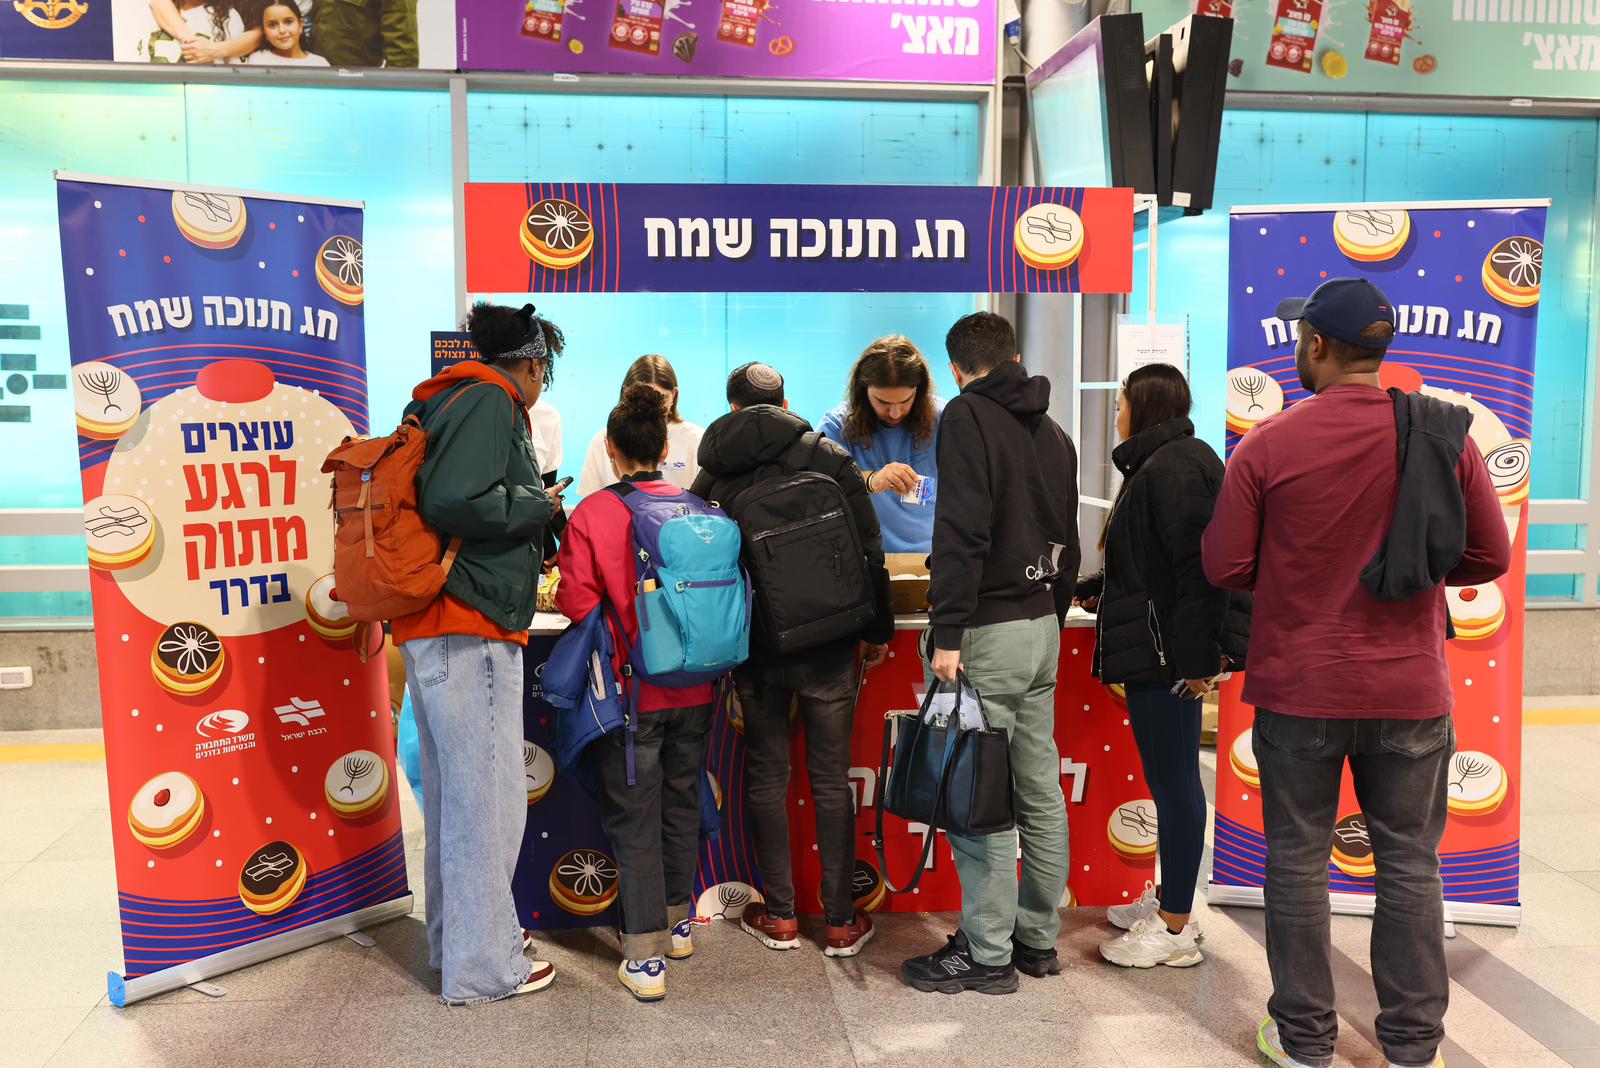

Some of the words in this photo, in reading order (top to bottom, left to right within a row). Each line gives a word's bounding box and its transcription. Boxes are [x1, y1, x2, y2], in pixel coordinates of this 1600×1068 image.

[890, 12, 979, 55] מאצ'
[644, 217, 753, 259] שמח
[770, 218, 897, 258] חנוכה
[912, 219, 965, 258] חג
[107, 296, 193, 337] שמח
[202, 295, 291, 331] חנוכה
[300, 306, 338, 340] חג
[1391, 304, 1449, 336] חנו
[1457, 309, 1502, 344] חג
[434, 339, 461, 348] לבכם
[434, 349, 466, 358] מצולם
[181, 421, 295, 453] עוצרים
[182, 455, 297, 512] לרגע
[183, 515, 308, 580] מתוק
[209, 573, 291, 615] בדרך
[195, 738, 231, 751] התחבורה
[222, 741, 256, 754] והבטיחות
[232, 733, 255, 744] משרד
[281, 731, 305, 741] ישראל
[307, 727, 327, 736] רכבת
[195, 748, 221, 759] בדרכים
